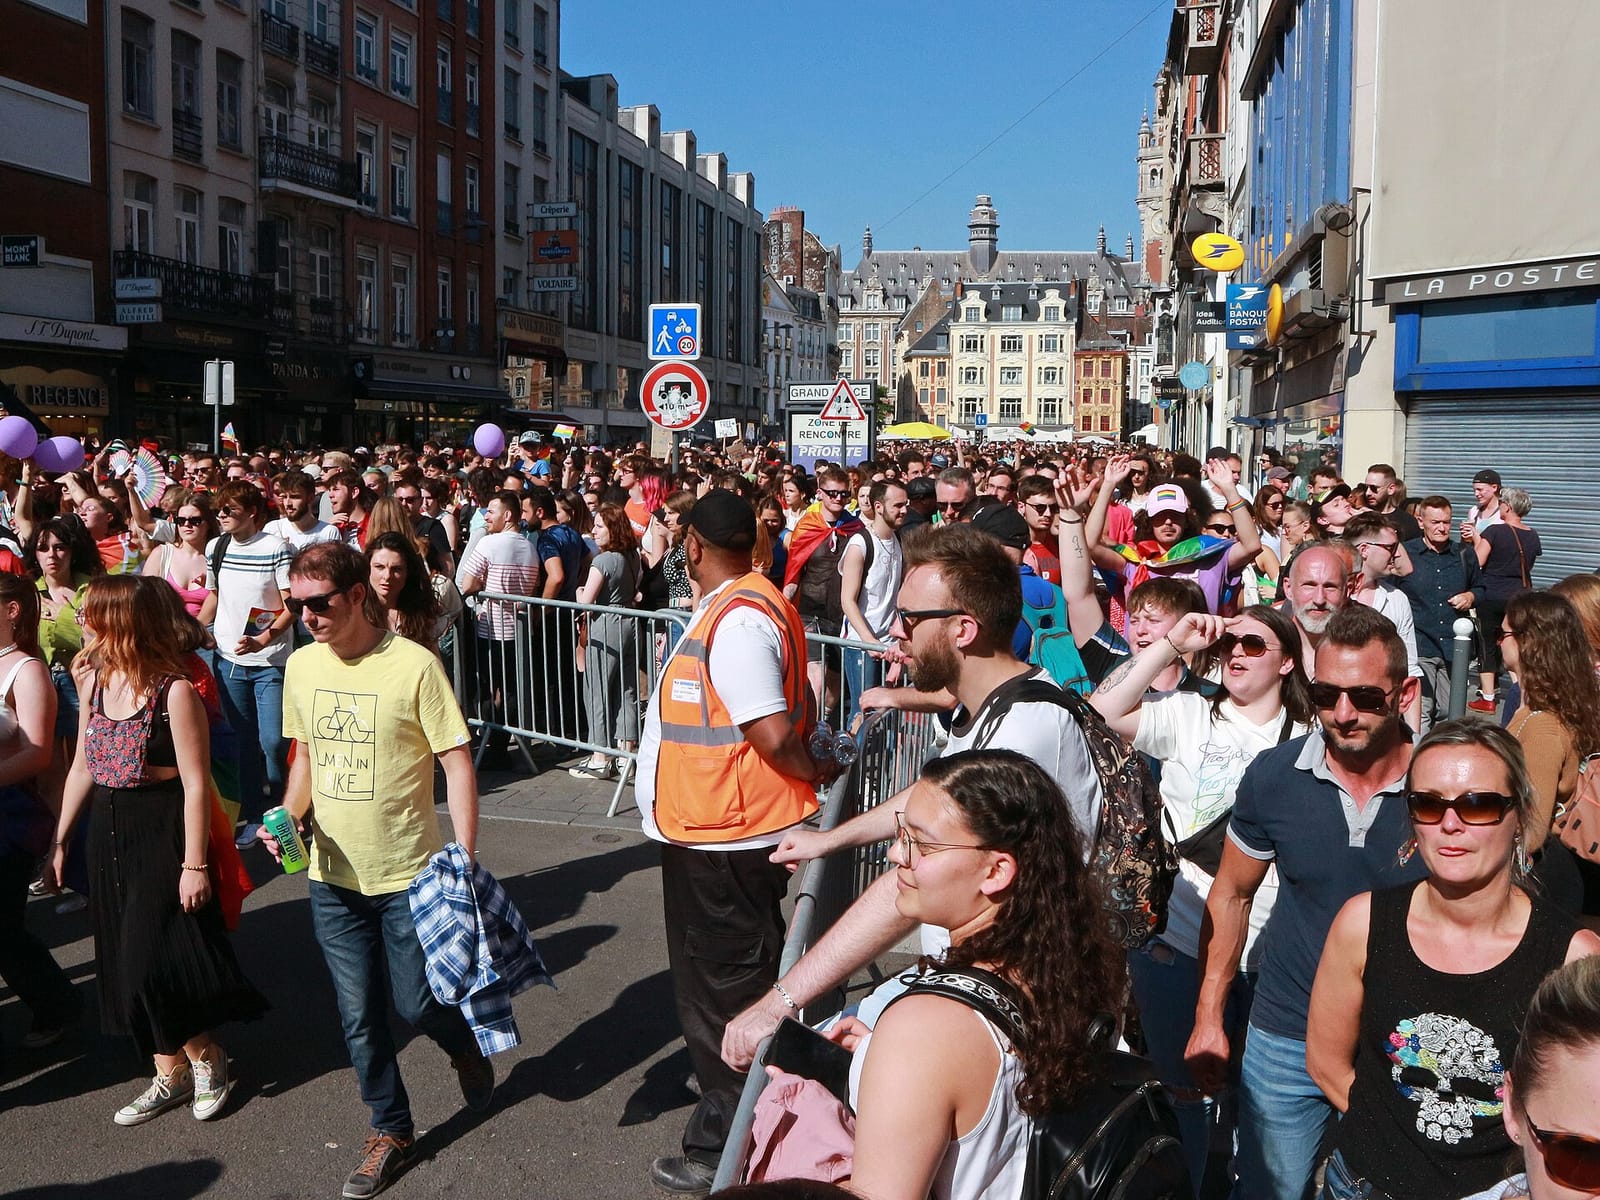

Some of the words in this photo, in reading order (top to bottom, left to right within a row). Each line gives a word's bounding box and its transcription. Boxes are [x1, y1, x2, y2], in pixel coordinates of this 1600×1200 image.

[5, 245, 30, 253] MONT
[5, 253, 30, 262] BLANC
[1405, 278, 1445, 297] LA
[1469, 262, 1597, 290] POSTE
[538, 280, 573, 289] VOLTAIRE
[1230, 310, 1266, 318] BANQUE
[682, 341, 692, 349] 20
[272, 362, 308, 377] PANDA
[32, 384, 106, 407] REGENCE
[791, 388, 829, 397] GRAND
[808, 419, 836, 427] ZONE
[800, 430, 861, 439] RENCONRE
[798, 445, 863, 457] PRIORTE
[325, 752, 352, 769] MEN
[356, 758, 369, 770] IN
[276, 822, 303, 864] BREWDOG
